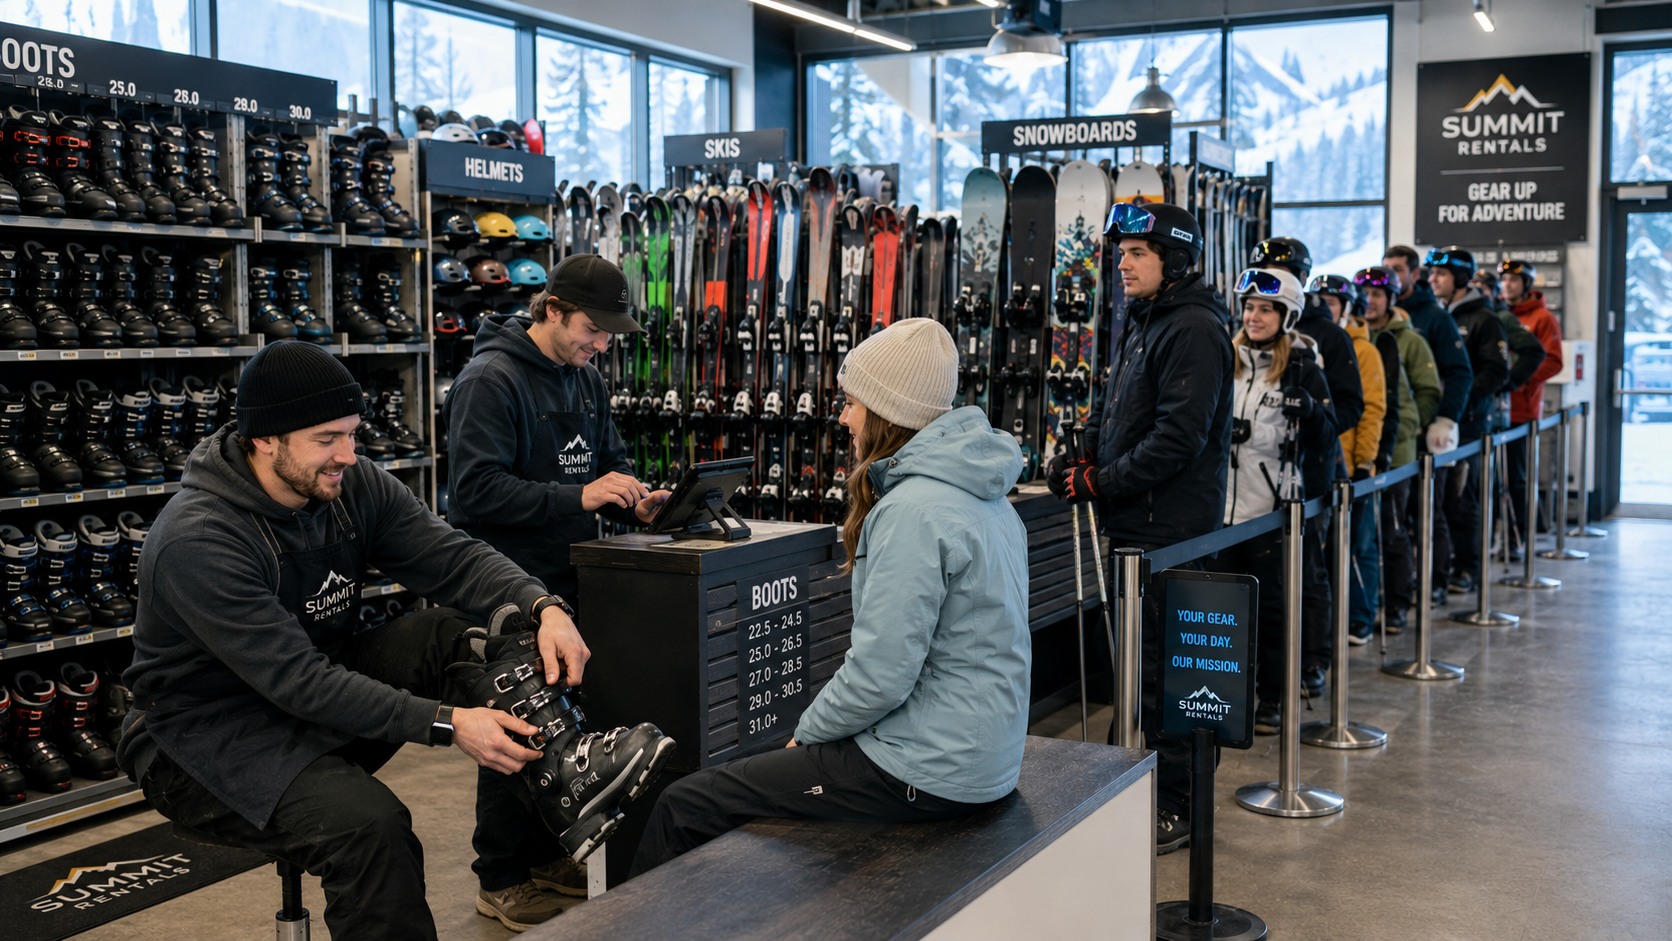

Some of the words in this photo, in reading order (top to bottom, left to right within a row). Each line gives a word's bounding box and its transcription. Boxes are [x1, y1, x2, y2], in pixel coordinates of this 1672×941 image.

[0, 37, 76, 79] OOTS
[109, 79, 136, 97] 25.0
[289, 104, 312, 120] 30.0
[1013, 120, 1137, 147] SNOWBOARDS
[1441, 110, 1565, 138] SUMMIT
[704, 137, 741, 159] SKIS
[1457, 137, 1547, 156] RENTALS
[464, 156, 524, 184] HELMETS
[1468, 182, 1511, 202] GEAR
[1514, 181, 1537, 201] UP
[1438, 204, 1469, 223] FOR
[1471, 202, 1566, 223] ADVENTURE
[305, 582, 356, 614] SUMMIT
[751, 575, 798, 611] BOOTS
[313, 600, 350, 621] RENTALS
[1177, 609, 1205, 624] YOUR
[1207, 612, 1238, 626] GEAR.
[748, 620, 771, 640] 22.5
[781, 610, 802, 630] 24.5
[748, 643, 772, 663] 25.0
[781, 633, 803, 653] 26.5
[1180, 632, 1208, 646] YOUR
[1210, 635, 1233, 648] DAY.
[748, 666, 772, 687] 27.0
[781, 656, 803, 676] 28.5
[1172, 655, 1193, 669] OUR
[1196, 658, 1241, 674] MISSION.
[749, 690, 772, 711] 29.0
[782, 678, 803, 699] 30.5
[1178, 700, 1232, 714] SUMMIT
[1185, 711, 1223, 721] RENTALS
[749, 713, 778, 734] 31.0+
[30, 853, 191, 913] SUMMIT
[74, 866, 190, 910] RENTALS
